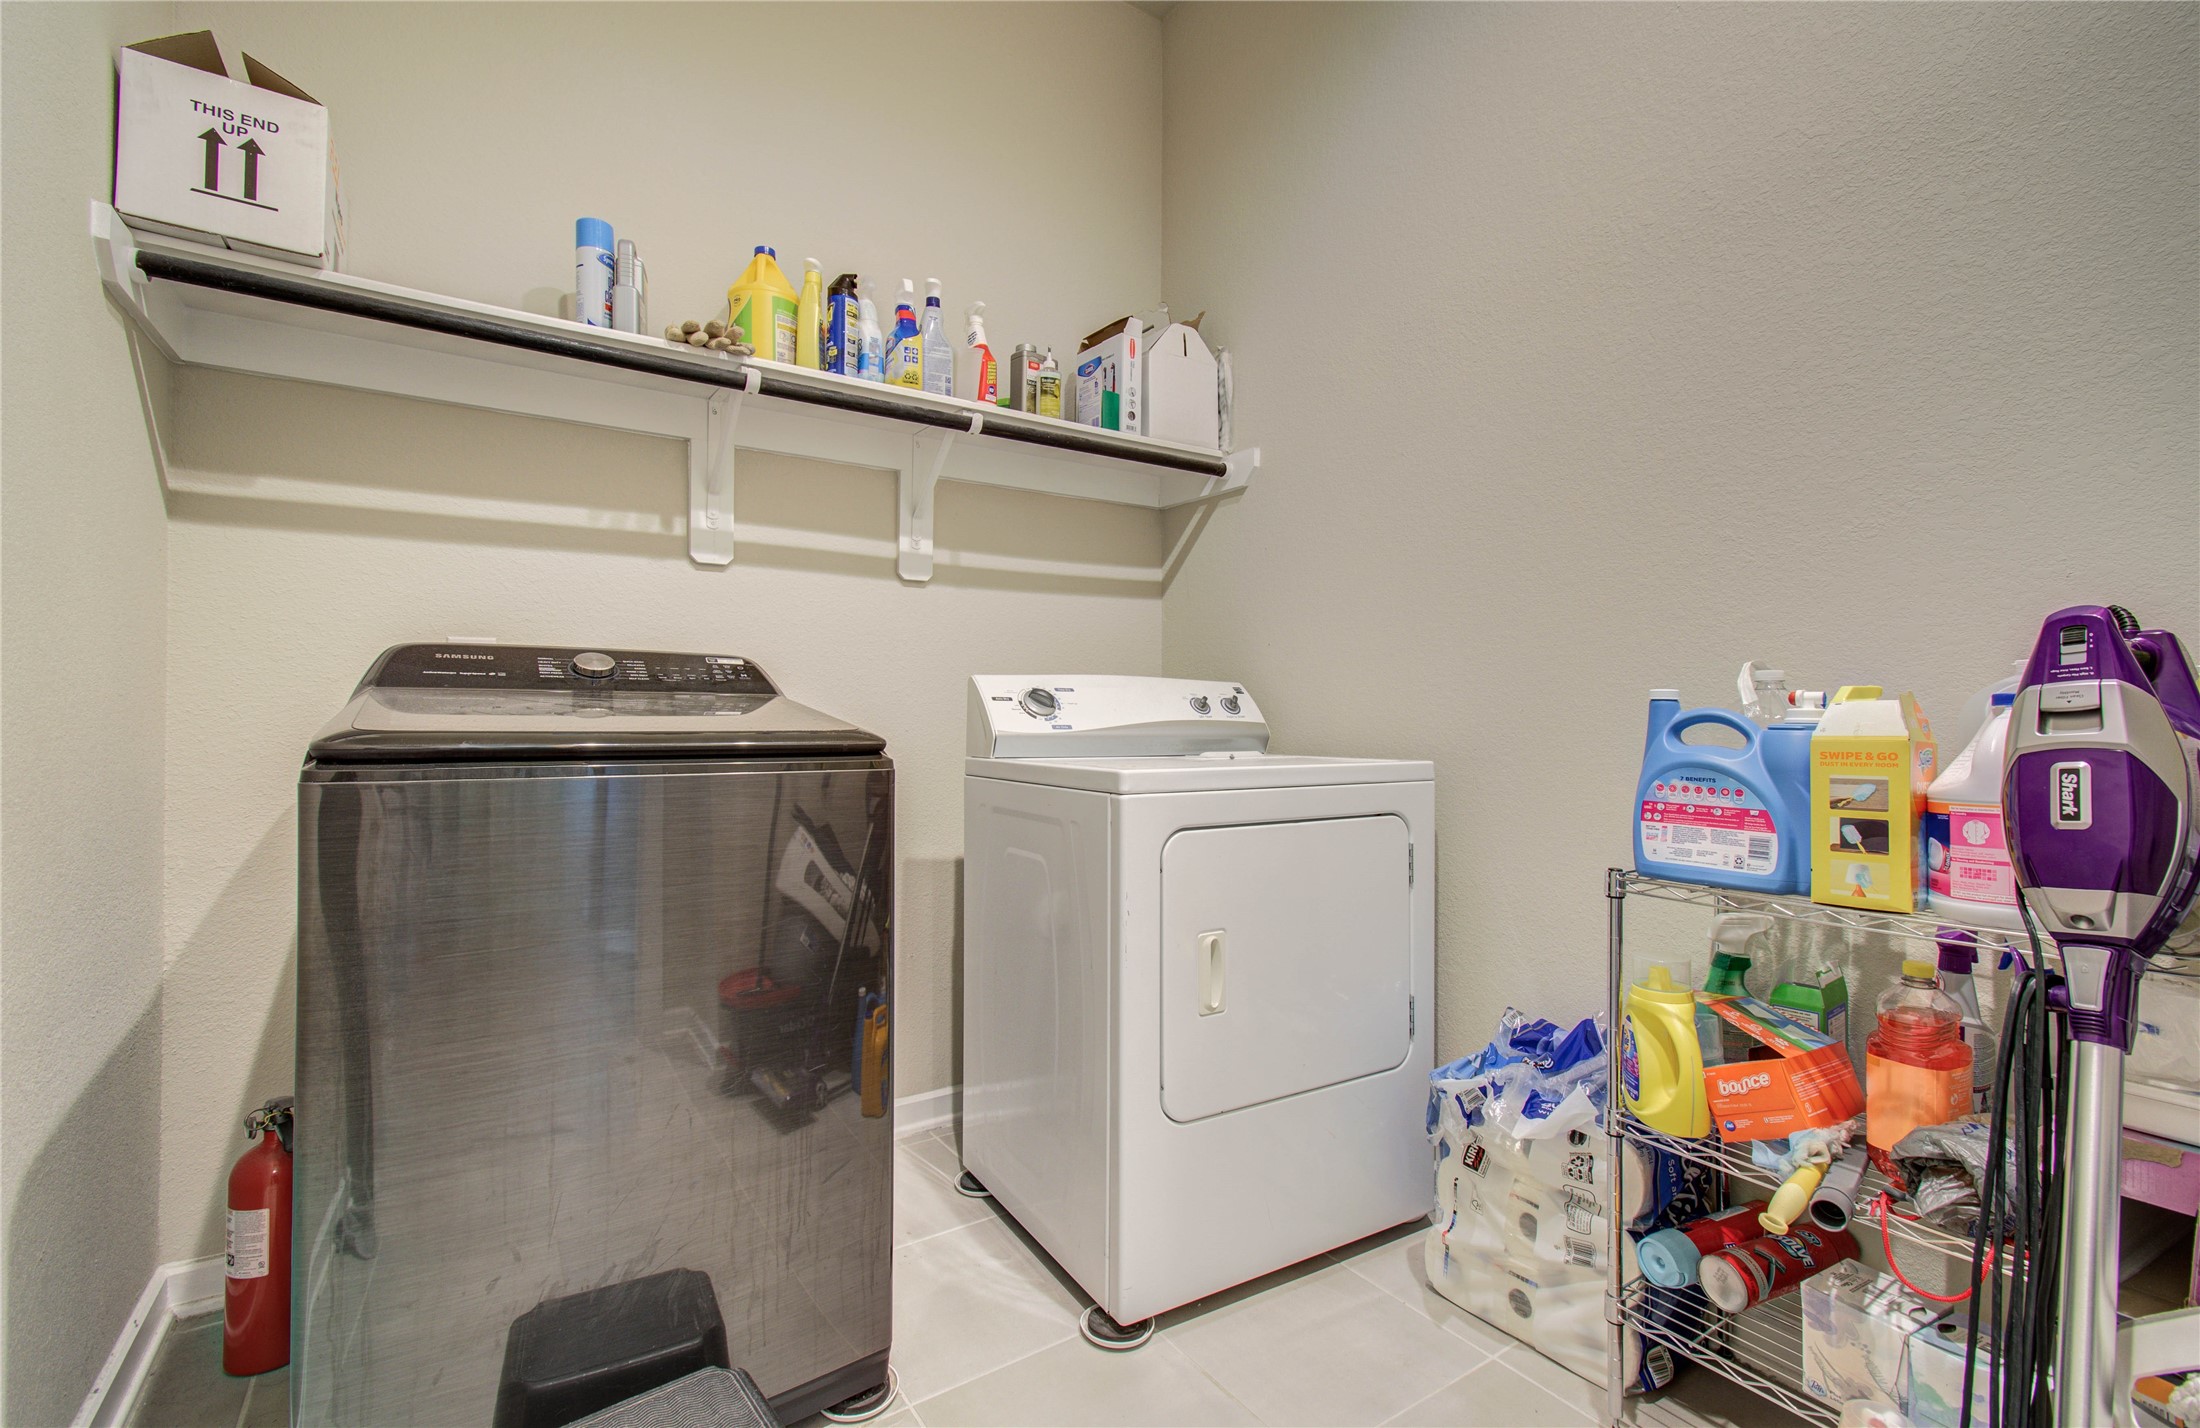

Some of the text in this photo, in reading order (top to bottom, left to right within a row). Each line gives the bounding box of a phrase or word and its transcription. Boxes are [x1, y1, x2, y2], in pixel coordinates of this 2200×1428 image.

[190, 99, 280, 134] THIS END
[222, 122, 249, 138] UP
[1820, 751, 1898, 761] SWIPE & GO
[2061, 772, 2078, 816] Shark
[1718, 1072, 1771, 1096] bounce
[1668, 1159, 1677, 1183] Soft
